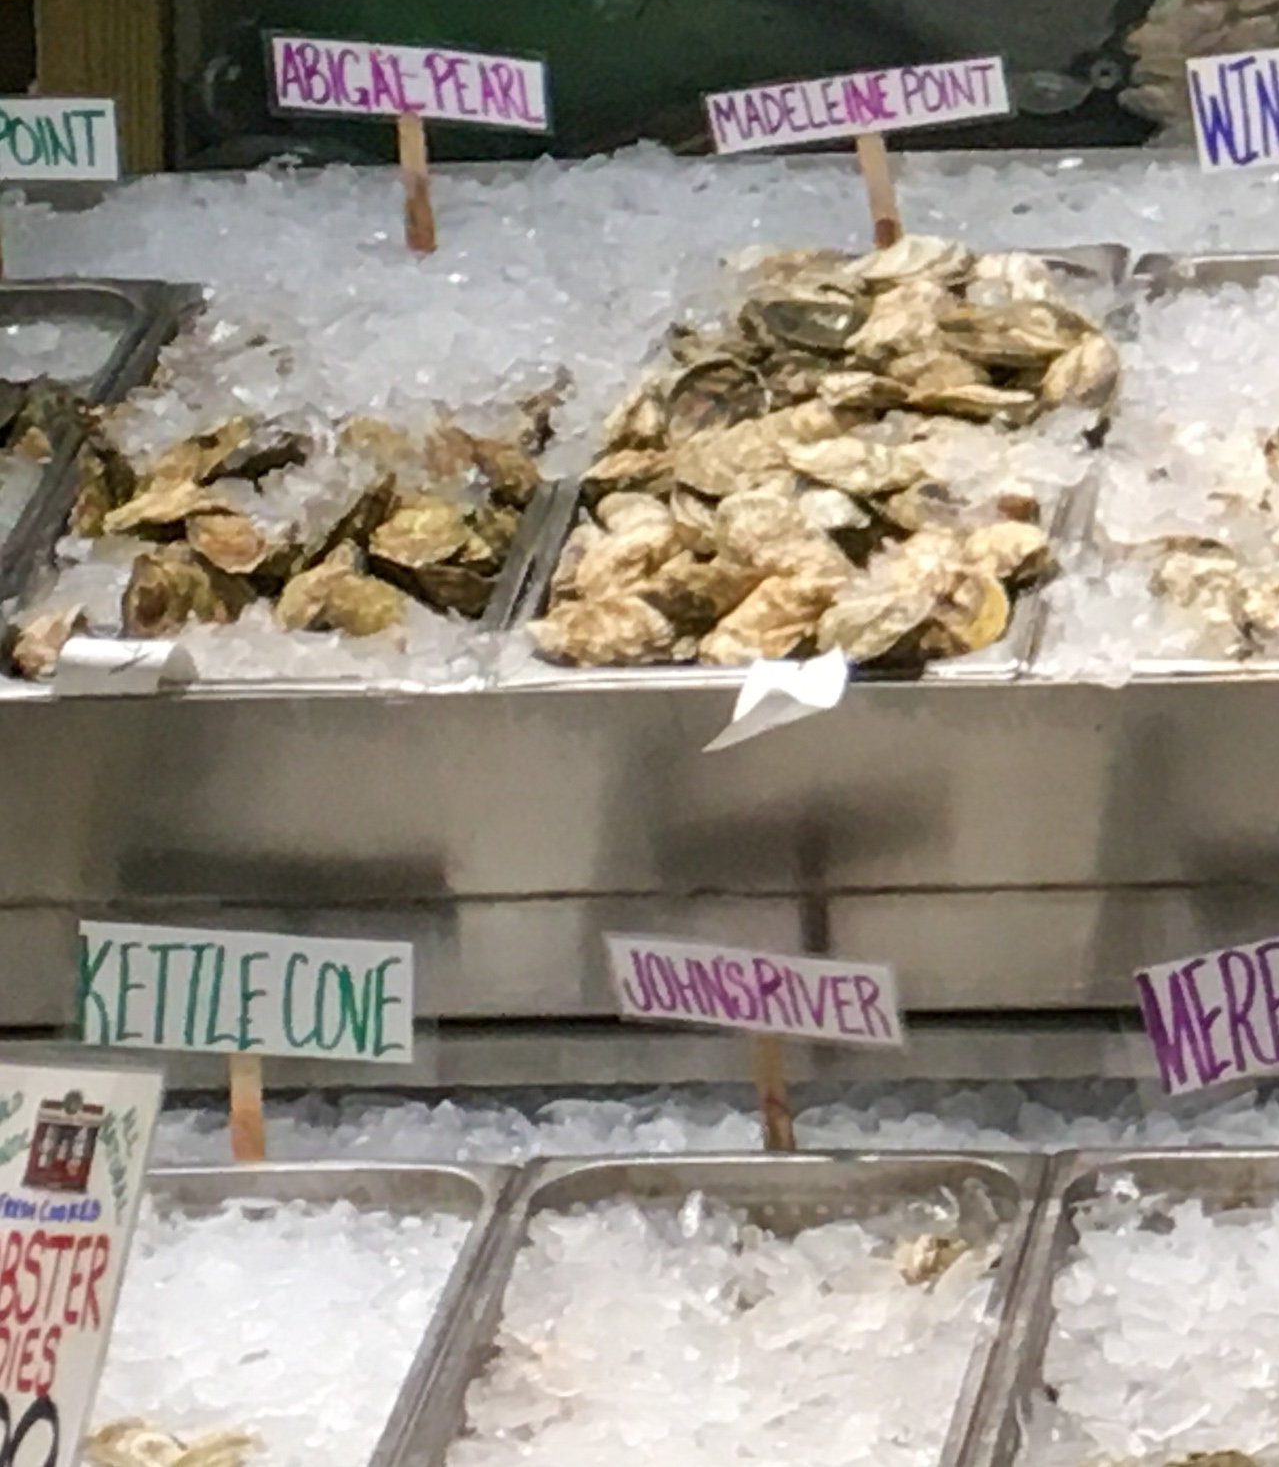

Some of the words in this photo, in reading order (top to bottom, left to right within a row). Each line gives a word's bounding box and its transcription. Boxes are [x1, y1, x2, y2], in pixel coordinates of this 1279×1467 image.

[427, 51, 544, 124] PEARL
[713, 72, 898, 145] MADELEINE
[901, 64, 995, 115] POINT
[78, 940, 270, 1046] KETTLE
[282, 954, 405, 1057] COVE
[751, 956, 894, 1039] RIVER
